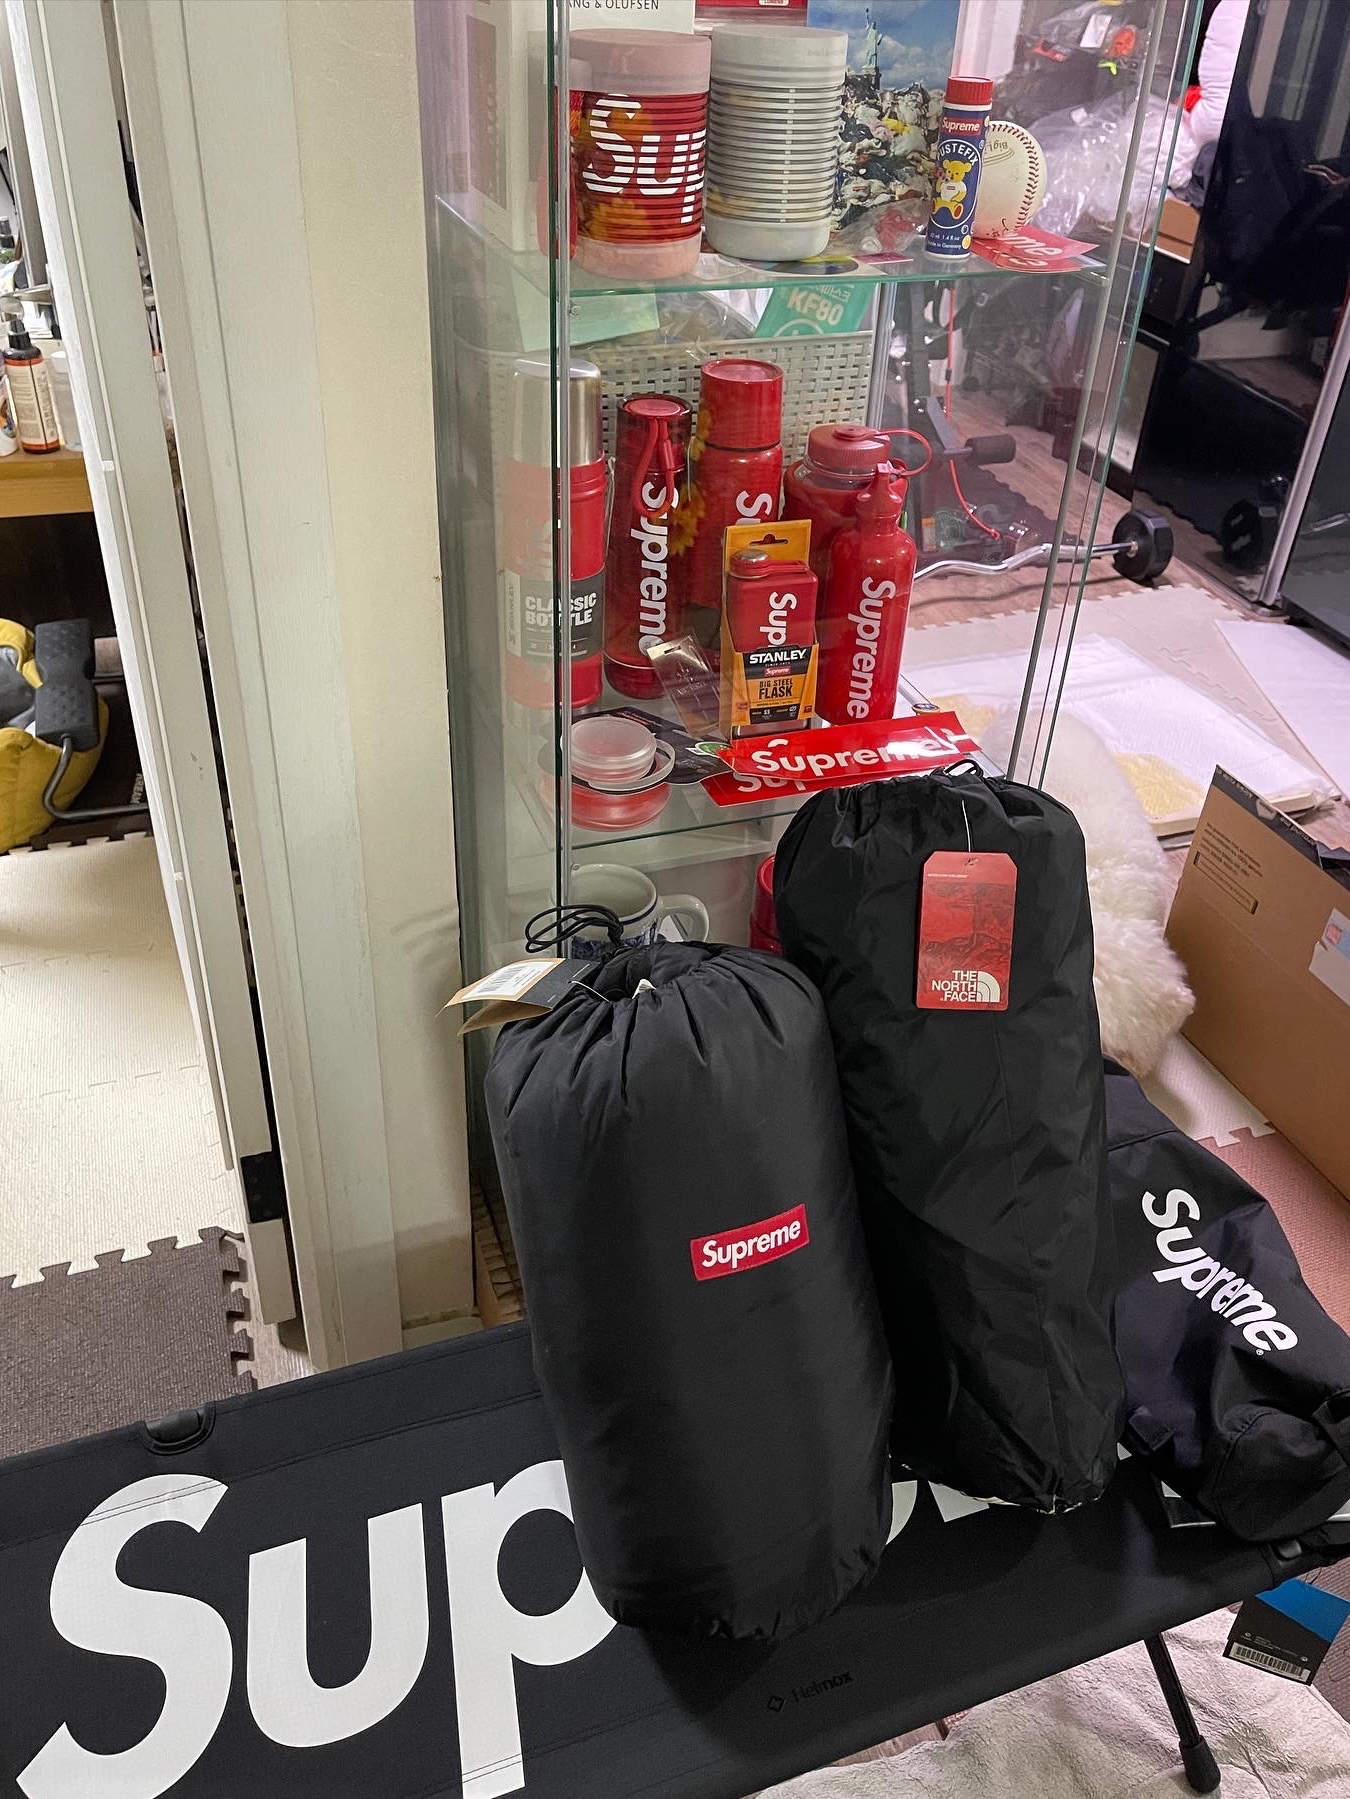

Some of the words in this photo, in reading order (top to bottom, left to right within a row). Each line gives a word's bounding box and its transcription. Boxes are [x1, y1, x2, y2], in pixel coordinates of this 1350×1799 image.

[605, 0, 659, 10] OLUFSEN
[942, 116, 980, 133] Supreme
[787, 287, 844, 326] KF80
[847, 576, 897, 719] Supreme
[749, 648, 807, 664] STANLEY
[765, 667, 790, 675] Supreme
[773, 678, 794, 687] STEEL
[758, 685, 793, 699] FLASK
[952, 970, 978, 981] THE
[931, 980, 977, 992] NORTH
[943, 990, 977, 1002] FACE
[702, 1220, 801, 1269] Supreme
[1142, 1188, 1299, 1352] Supreme
